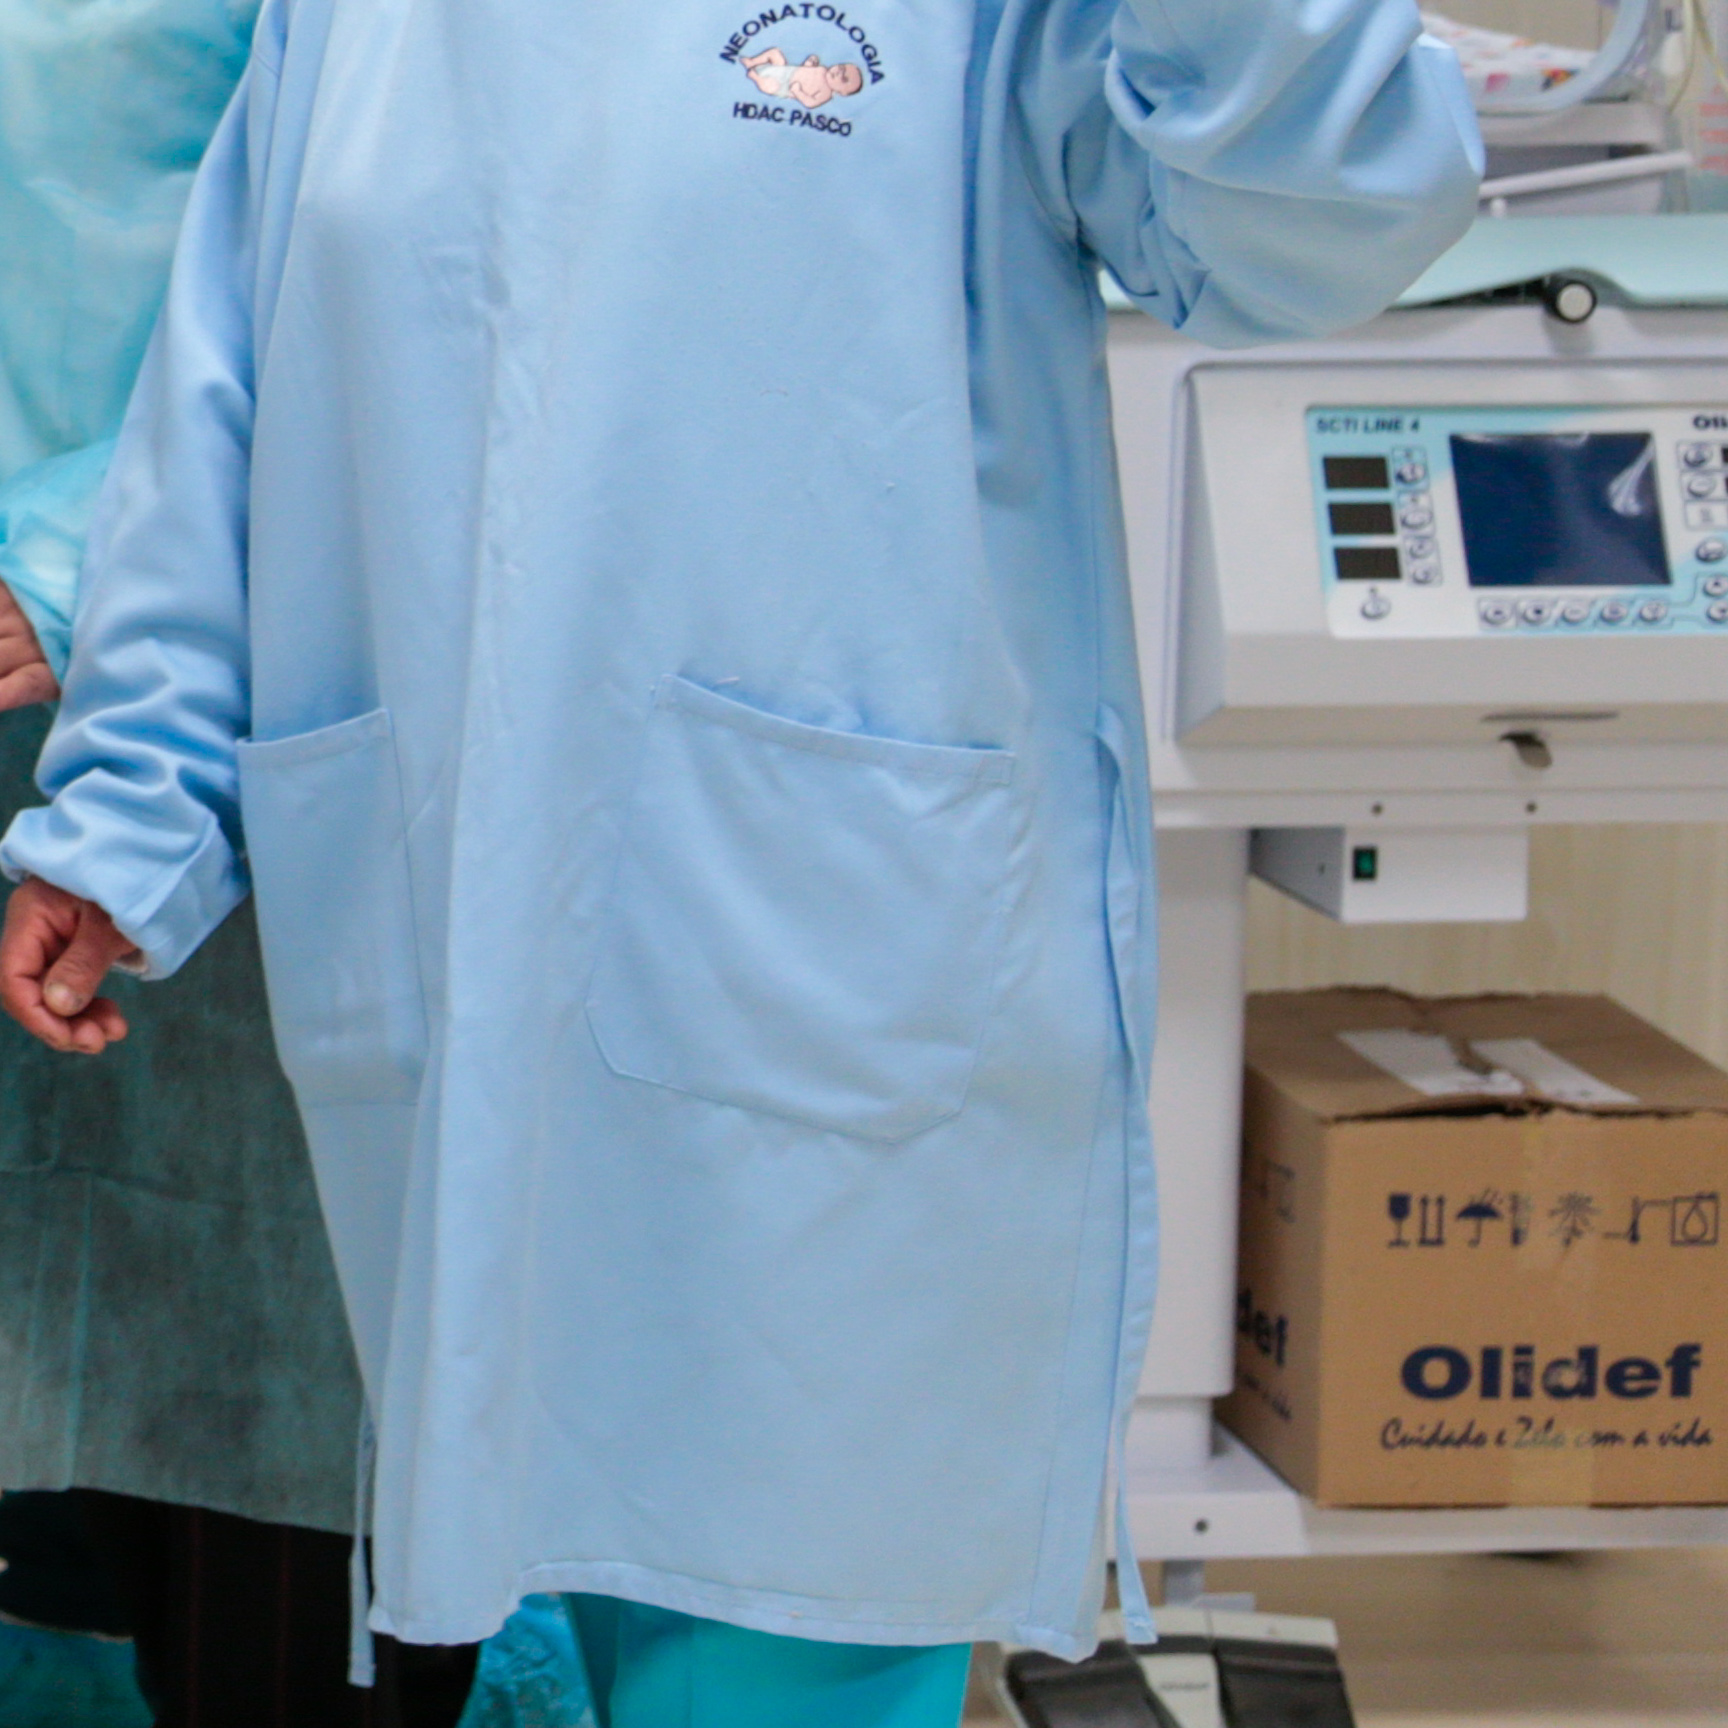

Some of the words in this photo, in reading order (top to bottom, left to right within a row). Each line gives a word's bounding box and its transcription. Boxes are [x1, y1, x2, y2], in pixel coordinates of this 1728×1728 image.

[719, 3, 885, 85] NEONATOLOGIA
[733, 101, 786, 123] HDAC
[790, 109, 852, 137] PASCO
[1401, 1343, 1703, 1401] Olidef
[1381, 1417, 1489, 1450] Cuidado
[1633, 1431, 1649, 1447] a
[1659, 1417, 1713, 1447] vida
